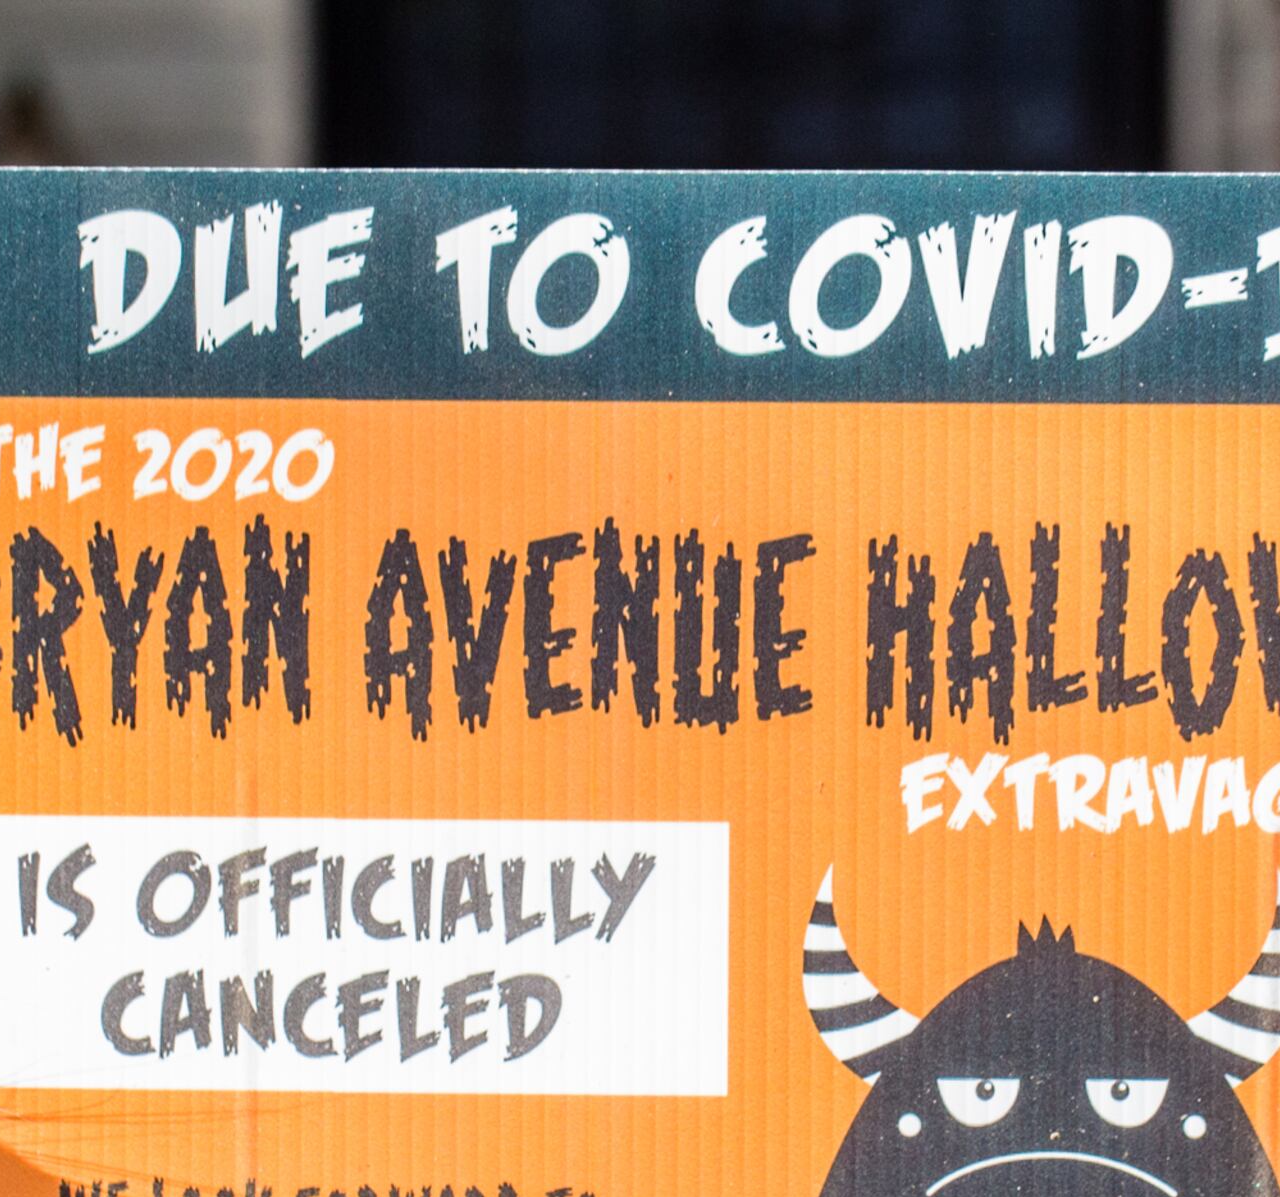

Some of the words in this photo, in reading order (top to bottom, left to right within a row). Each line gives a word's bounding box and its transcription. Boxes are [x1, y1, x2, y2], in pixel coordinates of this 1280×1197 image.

[79, 200, 374, 358] DUE
[436, 205, 630, 355] TO
[134, 429, 334, 501] 2020
[364, 518, 816, 741] AVENUE
[19, 845, 95, 939] IS
[138, 847, 655, 943] OFFICIALLY
[102, 970, 561, 1062] CANCELED
